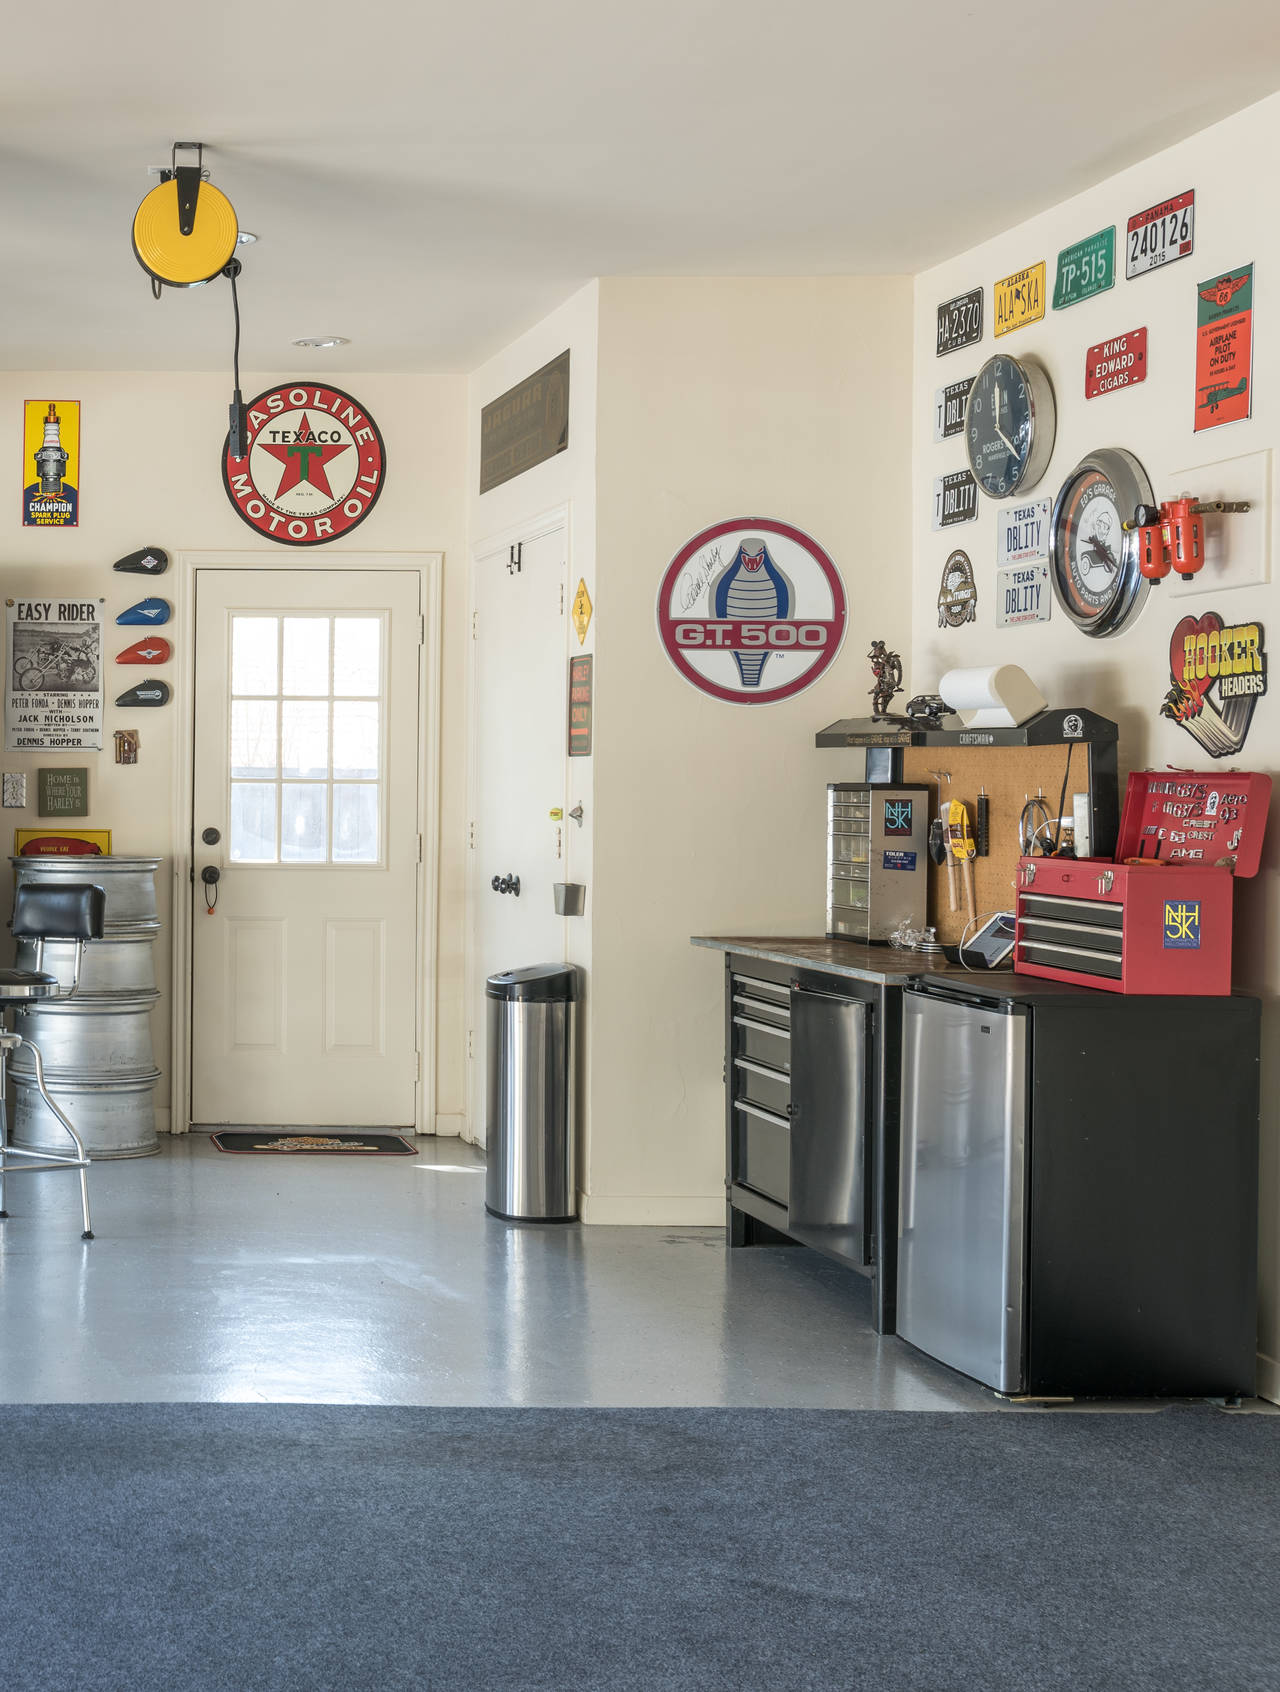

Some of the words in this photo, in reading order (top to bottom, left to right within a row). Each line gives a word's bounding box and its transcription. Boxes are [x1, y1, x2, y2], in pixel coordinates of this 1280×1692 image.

[1145, 204, 1174, 222] PANAMA
[1130, 208, 1188, 262] 240126
[1150, 251, 1166, 266] 2015
[1007, 272, 1030, 288] ALASKA
[948, 336, 966, 348] CUBA
[1210, 330, 1236, 348] AIRPLANE
[1104, 338, 1127, 358] KING
[1214, 342, 1231, 355] PILOT
[1096, 353, 1134, 378] EDWARD
[1210, 356, 1220, 367] ON
[1220, 352, 1236, 364] DUTY
[994, 362, 1002, 376] 12
[946, 382, 968, 396] TEXAS
[1100, 372, 1129, 392] CIGARS
[974, 398, 982, 413] 10
[1018, 384, 1025, 399] 2
[938, 404, 942, 429] T
[269, 430, 342, 443] TEXACO
[971, 428, 978, 442] 9
[982, 440, 1004, 454] ROGERS
[287, 446, 322, 480] T
[976, 454, 982, 470] 8
[1012, 466, 1018, 481] 5
[944, 472, 966, 486] TEXAS
[998, 477, 1006, 492] 6
[232, 474, 334, 538] MOTOR
[344, 470, 378, 518] OIL
[262, 494, 275, 506] MADE
[936, 494, 942, 516] T
[944, 483, 974, 514] DBLITY
[1080, 488, 1093, 508] ED'S
[29, 502, 72, 512] CHAMPION
[1014, 506, 1034, 522] TEXAS
[1006, 520, 1041, 552] DBLITY
[1013, 570, 1034, 584] TEXAS
[1070, 562, 1082, 591] AUTO
[1080, 588, 1099, 604] PARTS
[1100, 591, 1112, 604] AND
[1006, 584, 1041, 614] DBLITY
[18, 603, 52, 621] EASY
[58, 603, 95, 621] RIDER
[740, 624, 828, 646] 500
[1183, 624, 1262, 680] HOOKER
[1222, 674, 1264, 698] HEADERS
[12, 698, 29, 708] PETER
[32, 698, 48, 708] FONDA
[57, 698, 76, 709] DENNIS
[78, 699, 99, 709] HOPPER
[572, 708, 588, 722] ONLY
[960, 733, 989, 744] CRAFTSMAN
[47, 774, 72, 785] HOME
[66, 784, 82, 797] YOUR
[47, 797, 74, 810] HARLEY
[1182, 820, 1218, 829] CREST
[1188, 831, 1215, 840] CREST
[1170, 848, 1205, 858] AMG
